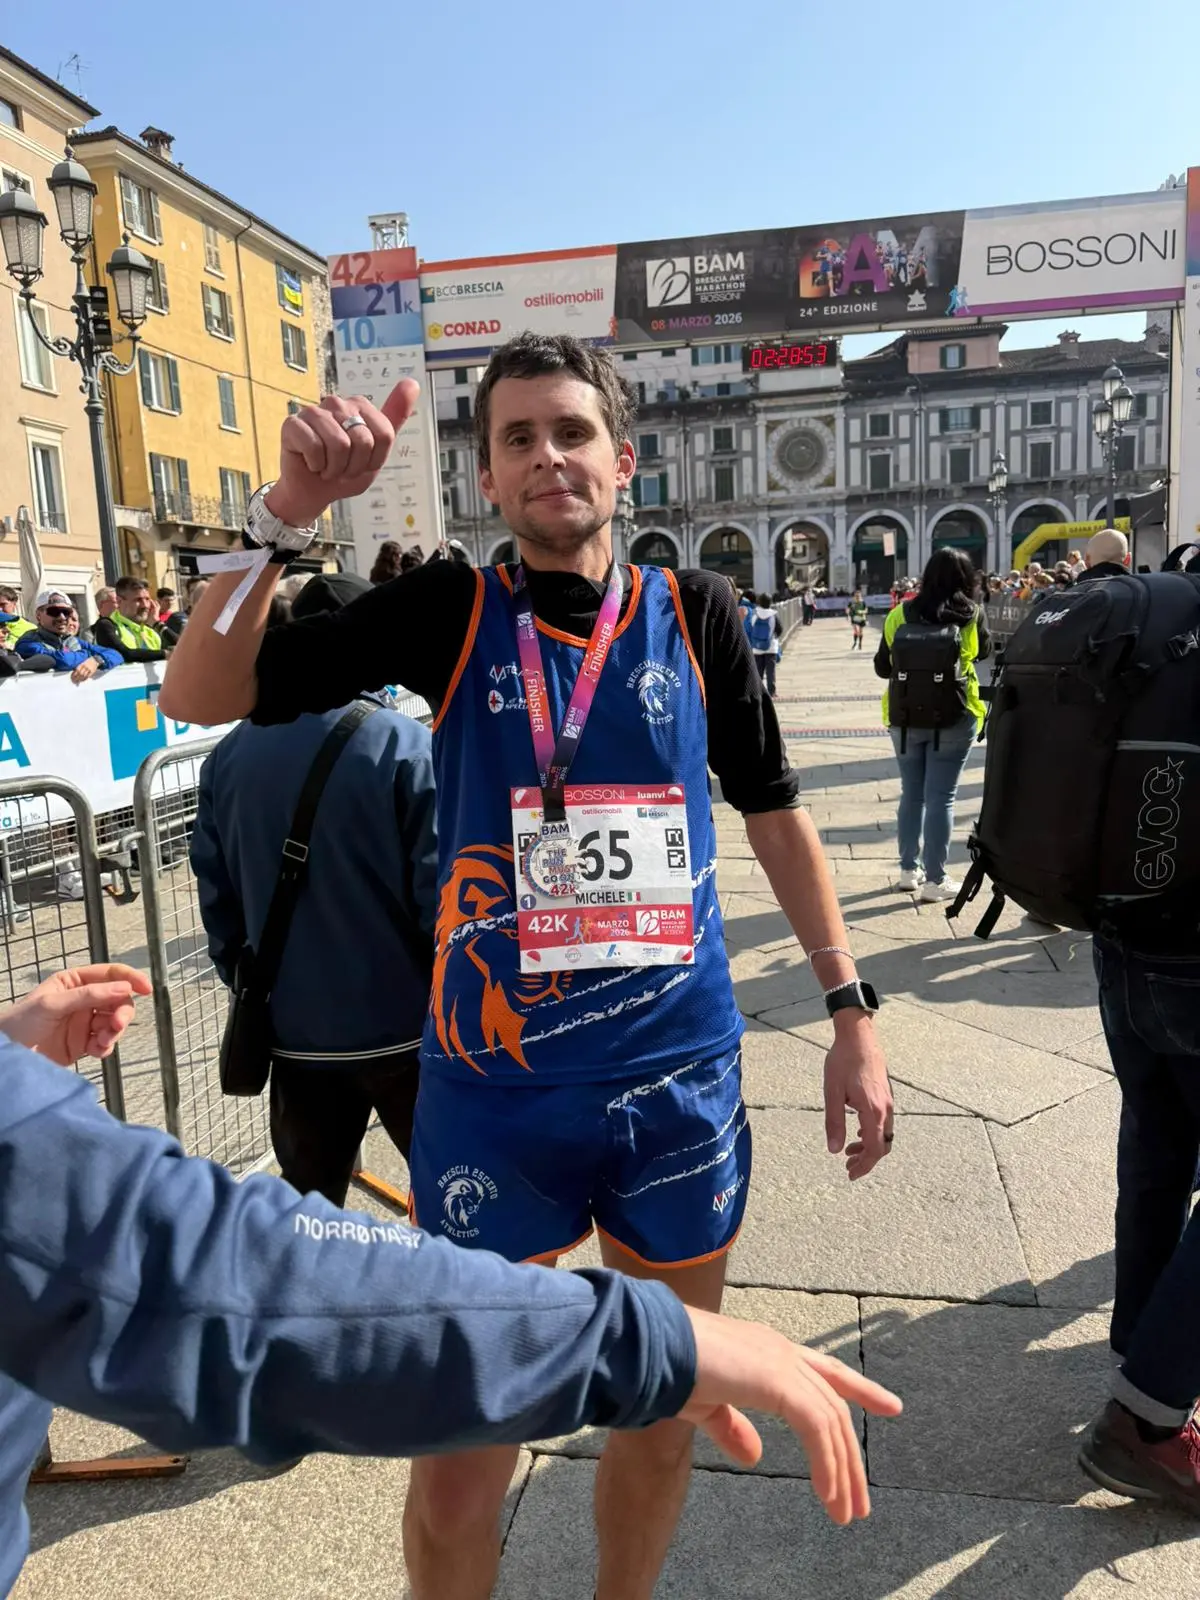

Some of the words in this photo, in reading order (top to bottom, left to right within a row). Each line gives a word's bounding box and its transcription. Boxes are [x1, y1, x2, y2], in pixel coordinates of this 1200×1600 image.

[986, 229, 1177, 276] BOSSONI
[693, 251, 745, 275] BAM
[729, 273, 745, 281] ART
[695, 281, 745, 292] MARATHON
[524, 288, 603, 307] ostiliomobili
[700, 292, 741, 303] BOSSONI
[823, 302, 878, 315] EDIZIONE
[443, 319, 501, 337] CONAD
[650, 319, 665, 331] 08
[669, 315, 712, 328] MARZO
[714, 312, 743, 325] 2026
[751, 344, 827, 368] 02:28:53
[590, 623, 613, 672] FINISHER
[527, 679, 544, 732] FINISHER
[564, 789, 625, 801] BOSSONI
[637, 791, 665, 799] luanvi
[541, 824, 570, 836] BAM
[547, 848, 567, 857] THE
[578, 830, 633, 881] 65
[543, 875, 558, 884] GO
[575, 891, 625, 905] MICHELE
[660, 910, 686, 919] BAM
[528, 914, 568, 933] 42K
[597, 920, 629, 928] MARZO
